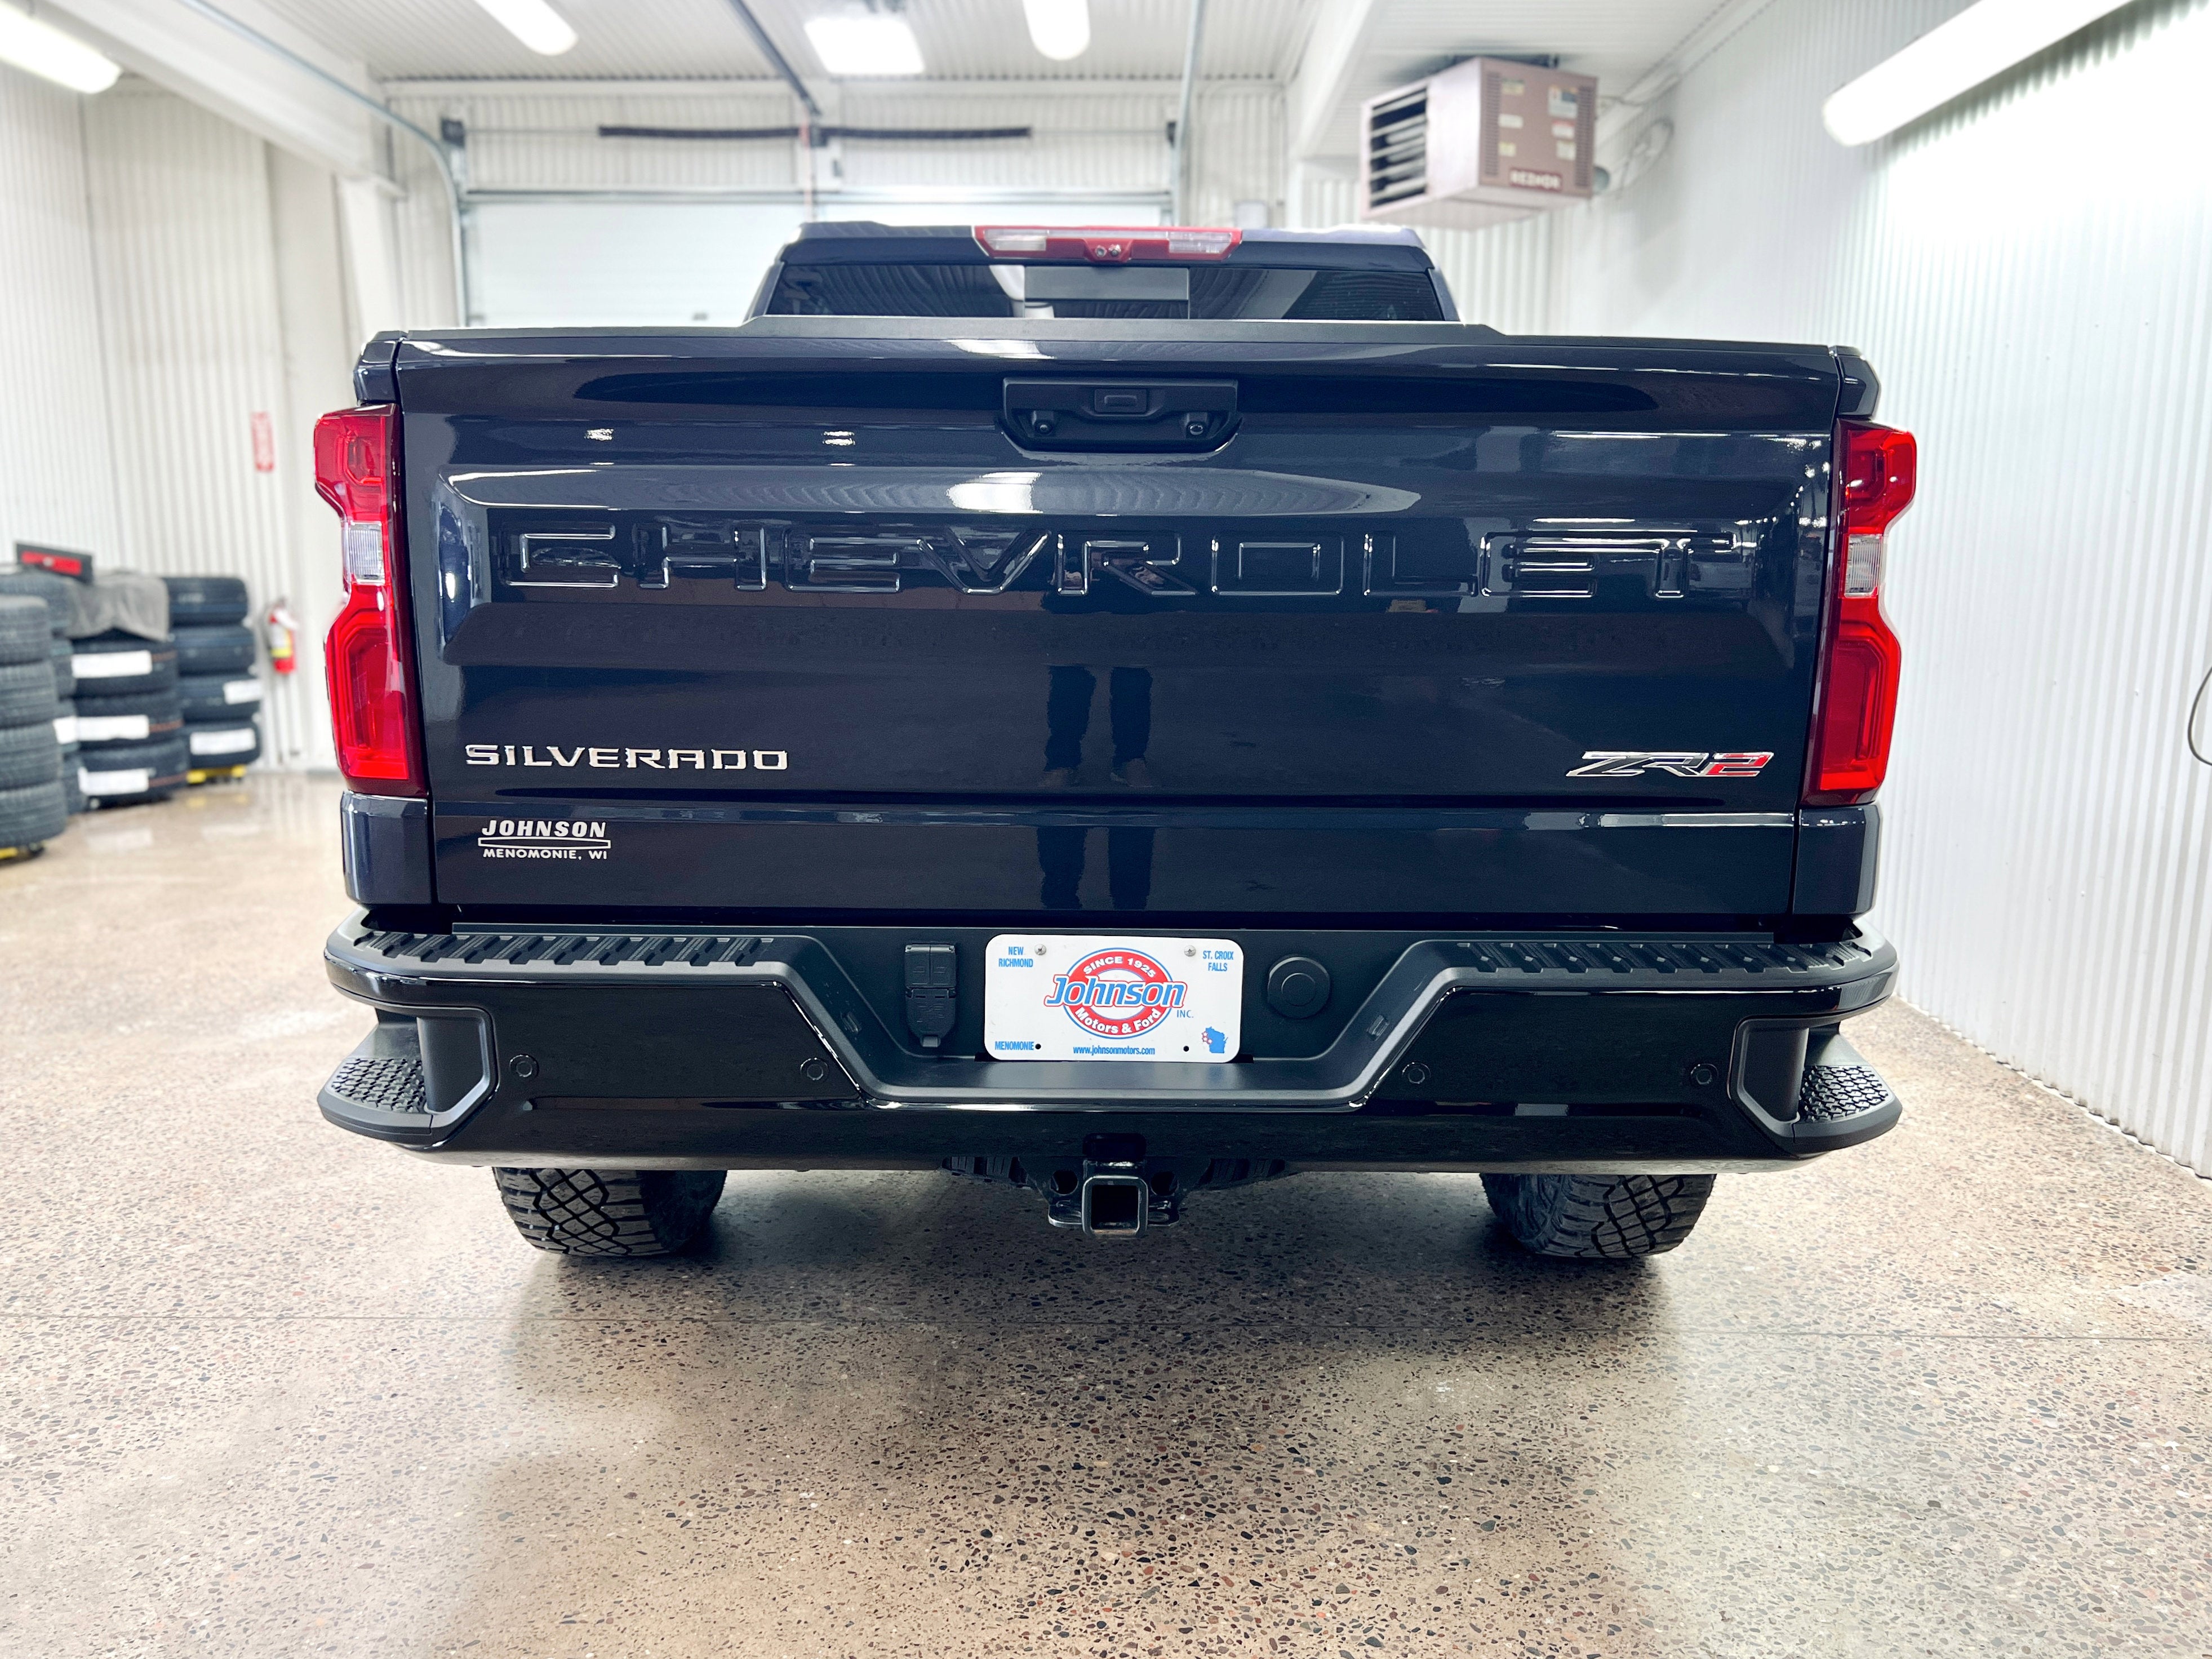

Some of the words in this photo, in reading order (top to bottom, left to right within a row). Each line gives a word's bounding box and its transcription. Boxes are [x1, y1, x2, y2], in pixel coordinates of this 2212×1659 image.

[501, 521, 1736, 598] CHEVROLET
[465, 744, 788, 770] SILVERADO
[1566, 751, 1774, 777] ZR2
[482, 820, 606, 837] JOHNSON
[482, 849, 582, 860] MENOMONIE,
[588, 850, 607, 860] WI
[1008, 946, 1024, 955] NEW
[1202, 950, 1212, 959] ST.
[1214, 951, 1234, 960] CROIX
[998, 958, 1033, 968] RICHMOND
[1083, 956, 1123, 974] SINCE
[1127, 957, 1156, 978] 1925
[1207, 962, 1228, 972] FALLS
[1046, 976, 1185, 1006] Johnson
[1176, 1010, 1194, 1018] INC.
[1074, 1006, 1119, 1033] Motors
[1121, 1023, 1132, 1034] &
[1133, 1008, 1161, 1031] Ford
[994, 1041, 1034, 1050] MENOMONIE
[1073, 1045, 1155, 1056] www.johnsonmotors.com
